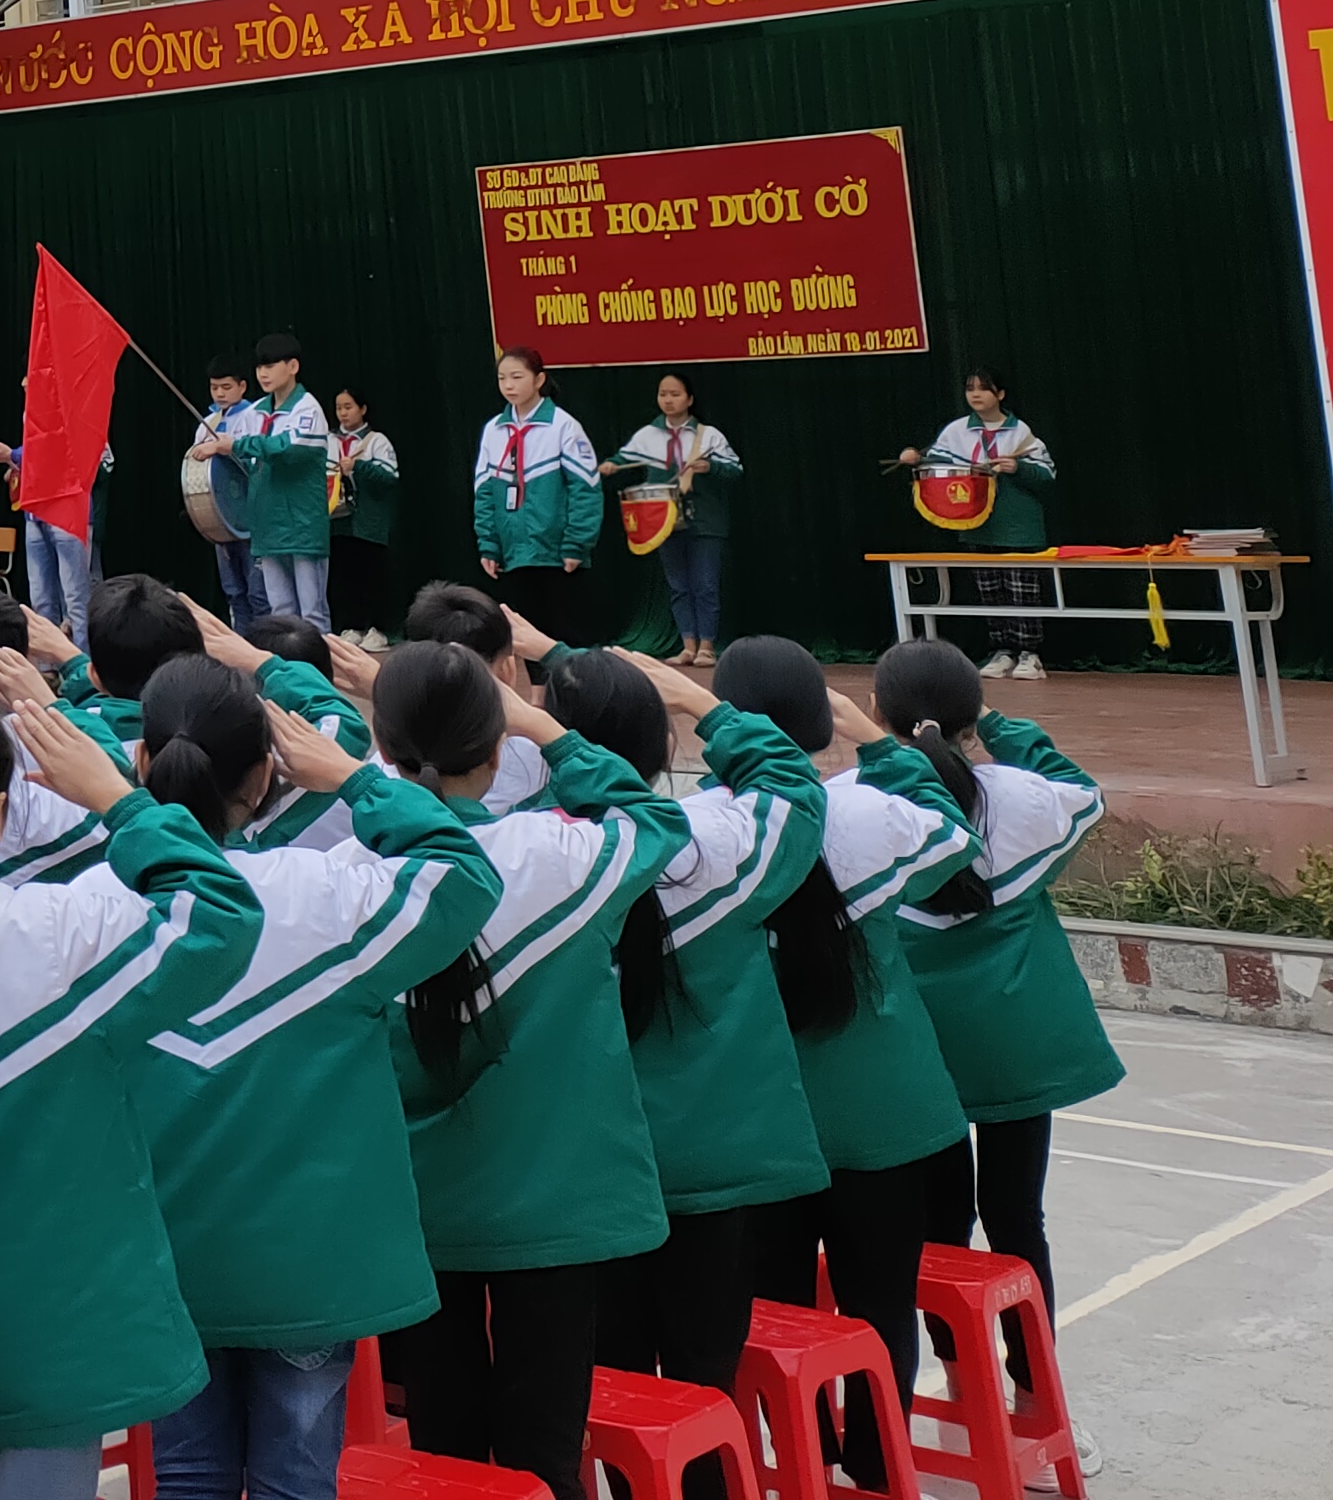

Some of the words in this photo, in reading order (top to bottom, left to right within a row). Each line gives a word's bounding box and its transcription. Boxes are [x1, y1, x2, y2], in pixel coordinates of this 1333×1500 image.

[109, 22, 223, 88] CỘNG
[234, 3, 328, 65] HÒA
[503, 206, 594, 242] SINH
[604, 198, 698, 240] HOẠT
[708, 181, 803, 228] DƯỚI
[814, 175, 868, 218] CỜ
[520, 250, 566, 277] THÁNG
[569, 255, 577, 274] 1
[535, 286, 589, 326] PHÒNG
[598, 278, 656, 323] CHỐNG
[660, 287, 697, 325] BẠO
[703, 281, 737, 322] LỰC
[743, 280, 782, 319] HỌC
[790, 265, 857, 312] ĐƯỜNG
[747, 330, 775, 356] BẢO
[807, 328, 841, 353] NGÀY
